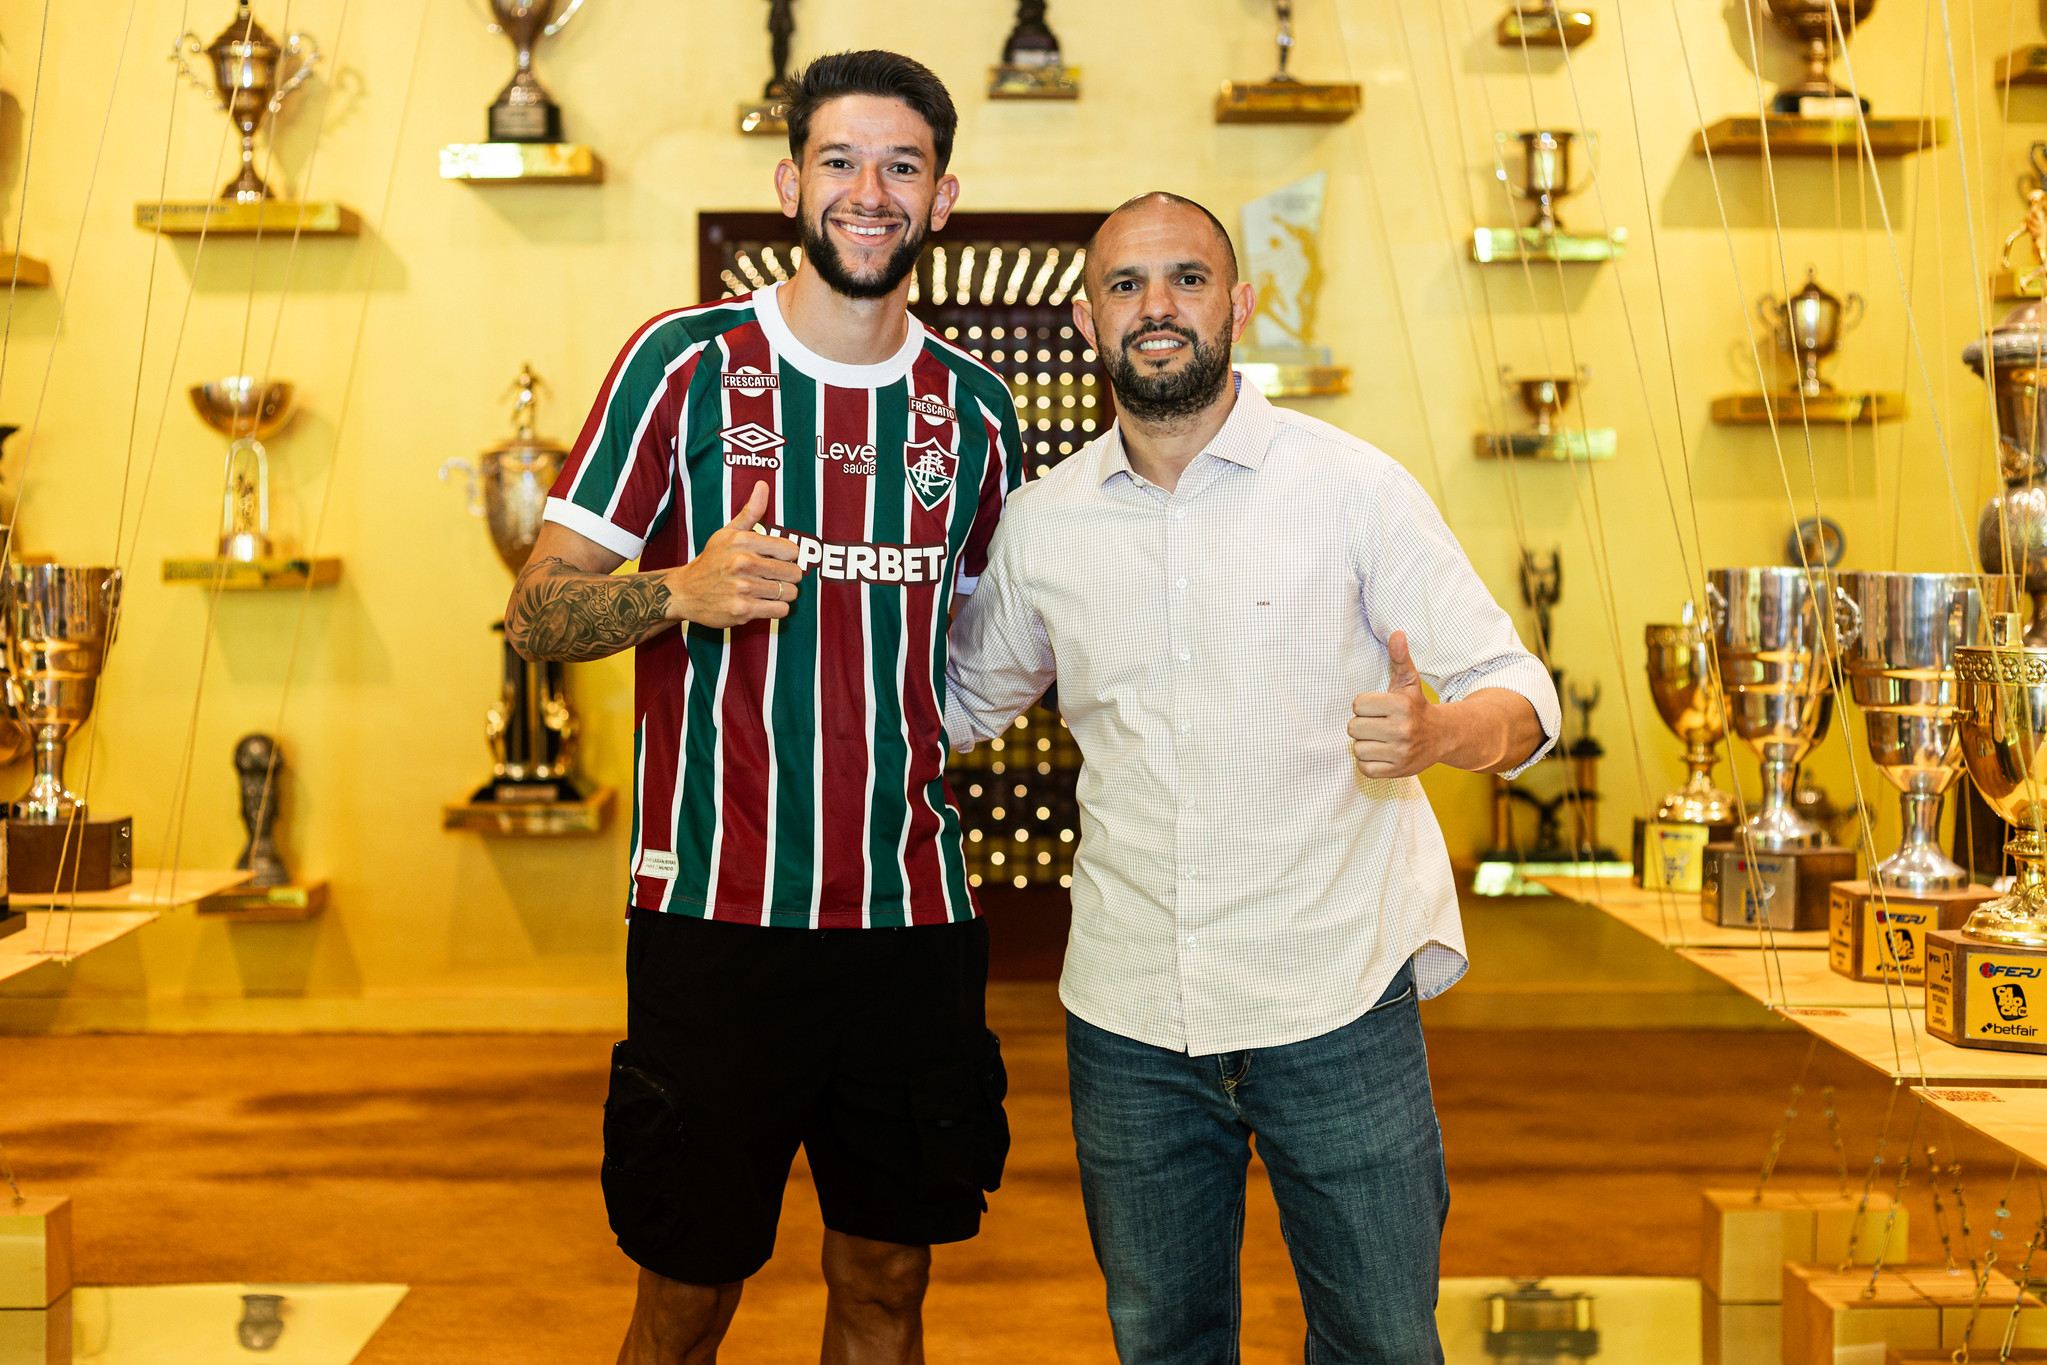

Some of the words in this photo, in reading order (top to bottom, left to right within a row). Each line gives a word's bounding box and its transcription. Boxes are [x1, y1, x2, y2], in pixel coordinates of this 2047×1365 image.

[724, 375, 777, 387] FRESCATTO
[911, 399, 955, 420] FRESCATTO
[817, 437, 876, 462] Leve
[725, 454, 778, 469] umbro
[843, 461, 876, 474] saúde
[752, 522, 945, 582] PERBET
[1993, 966, 2042, 979] FERJ
[1994, 1023, 2039, 1037] betfair
